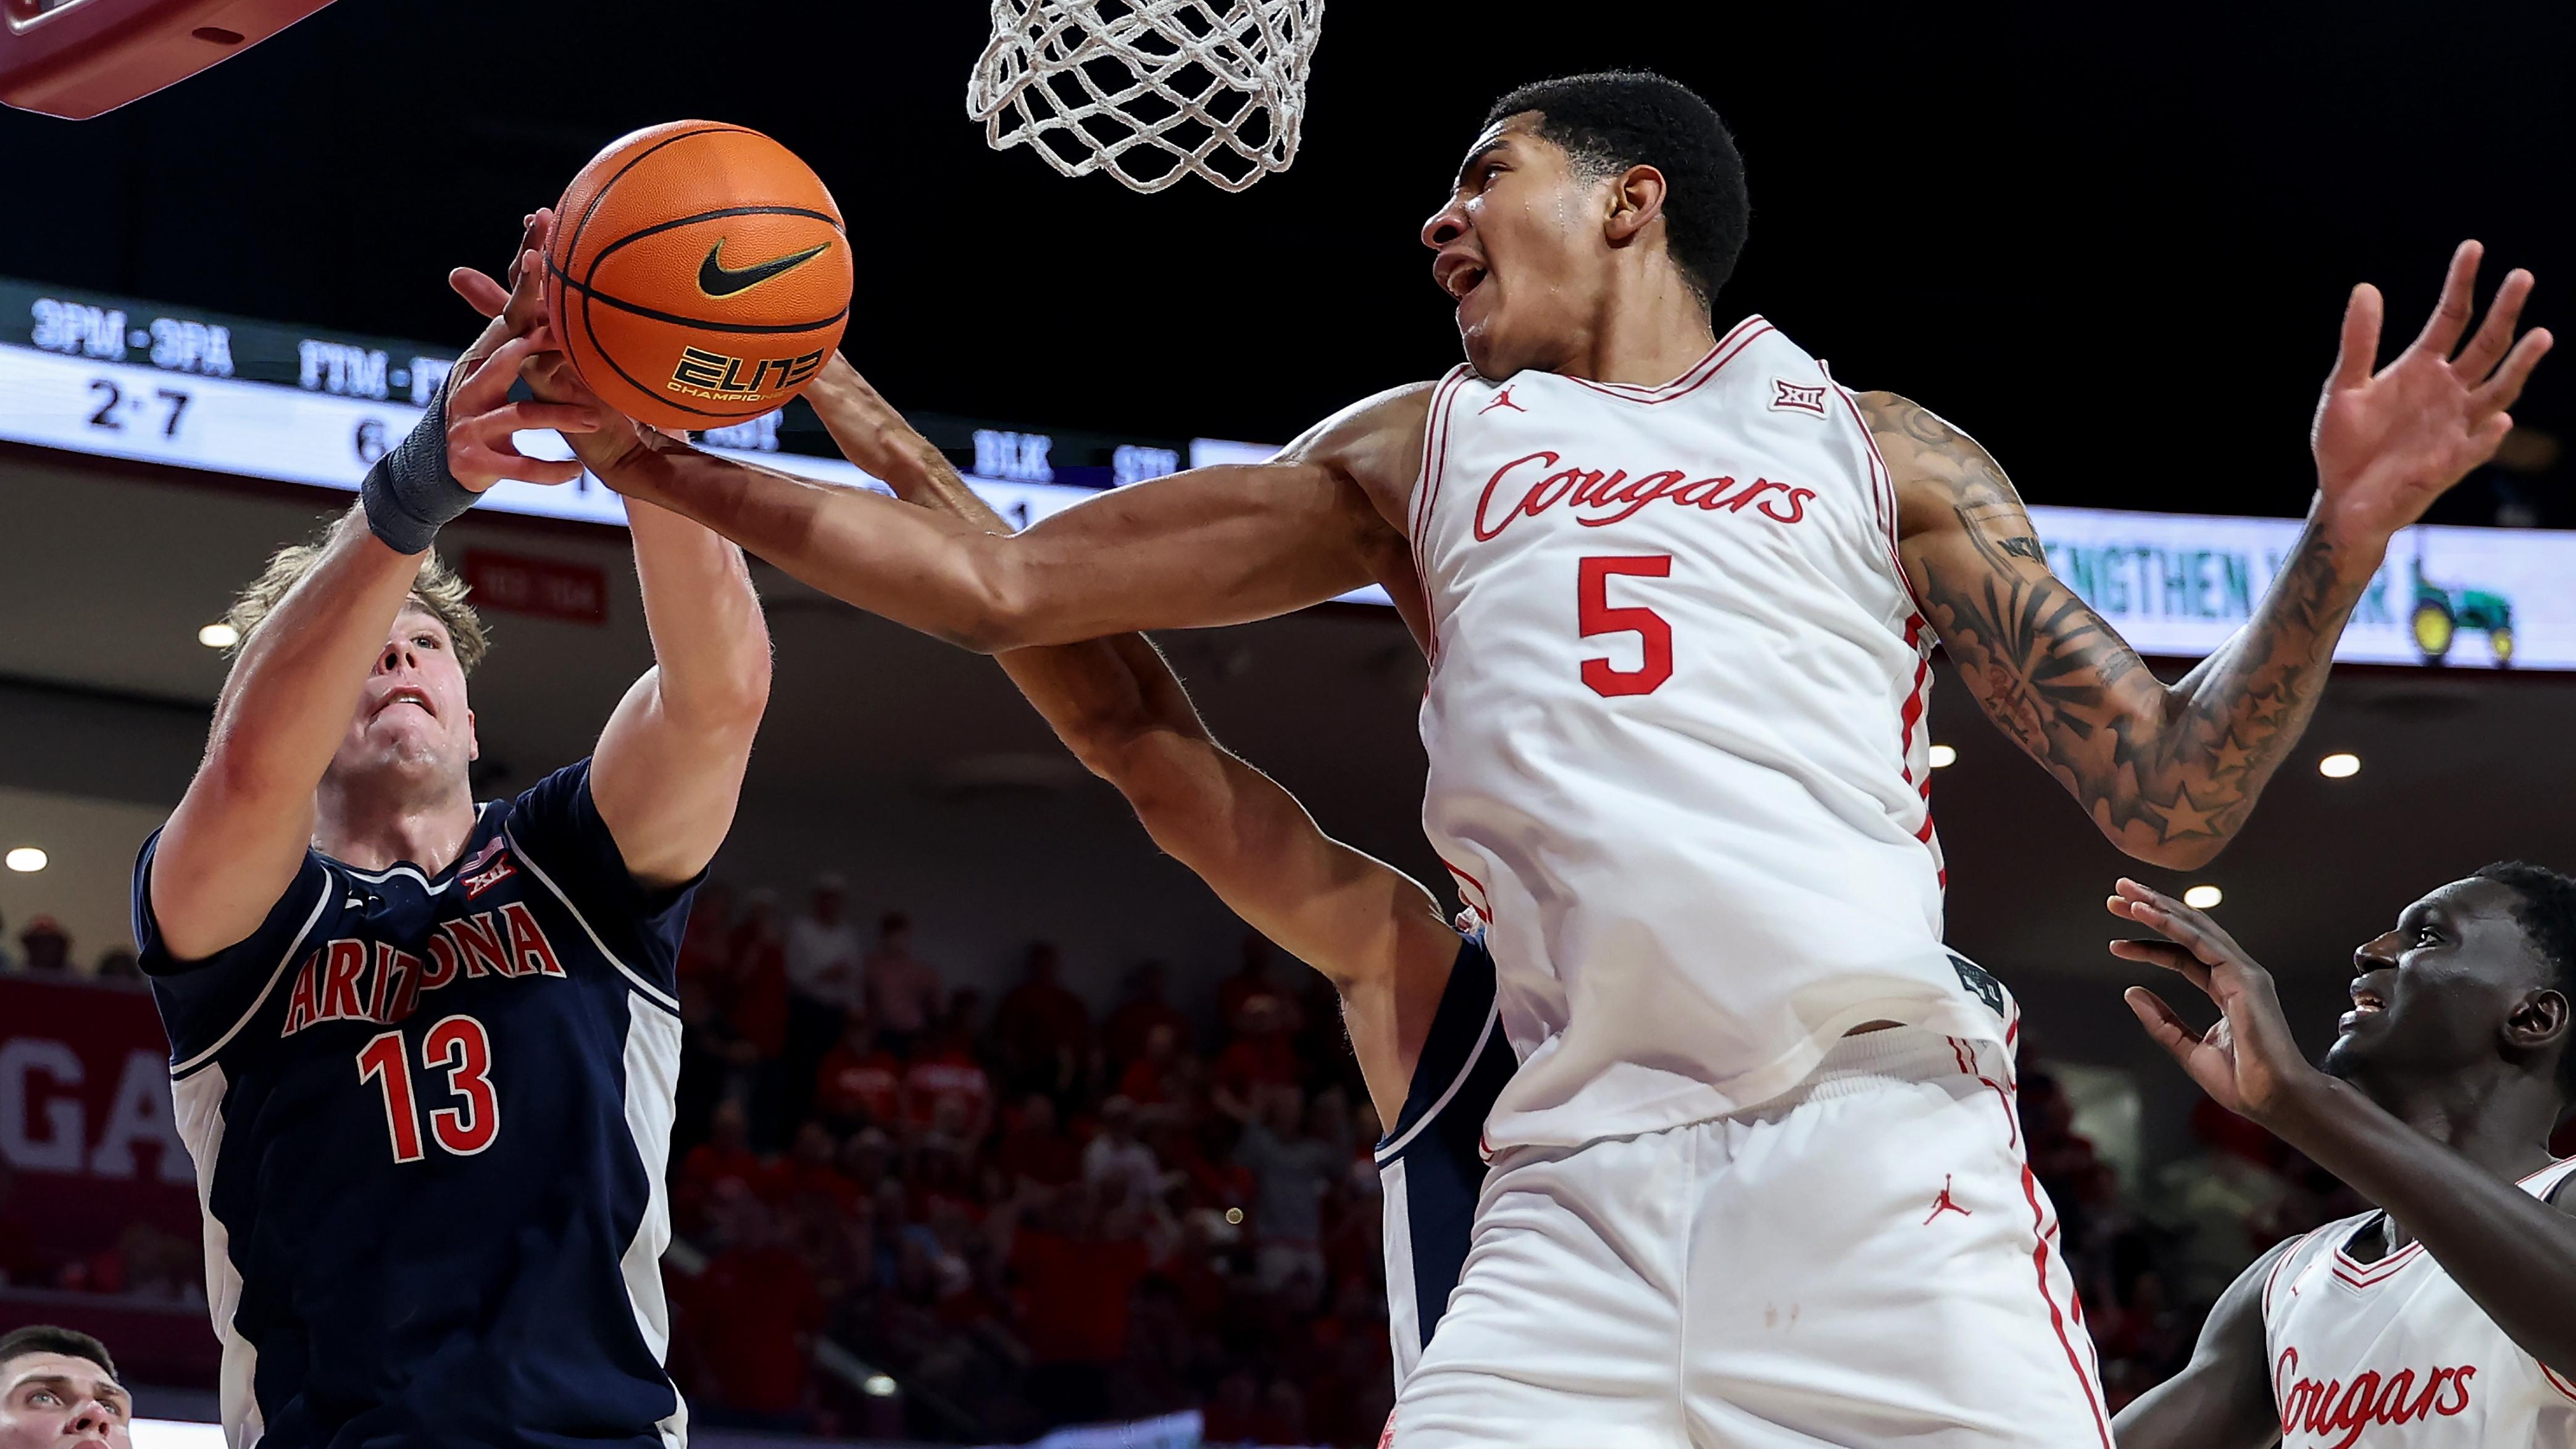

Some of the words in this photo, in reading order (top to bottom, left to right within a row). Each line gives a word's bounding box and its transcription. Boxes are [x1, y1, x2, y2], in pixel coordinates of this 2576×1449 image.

[672, 345, 825, 393] ELITE
[1473, 451, 1816, 542] Cougars
[1577, 555, 1673, 698] 5
[2041, 539, 2251, 618] NGTHEN
[281, 901, 567, 1038] ARIZONA
[356, 1014, 499, 1164] 13
[2276, 1346, 2477, 1449] Cougars
